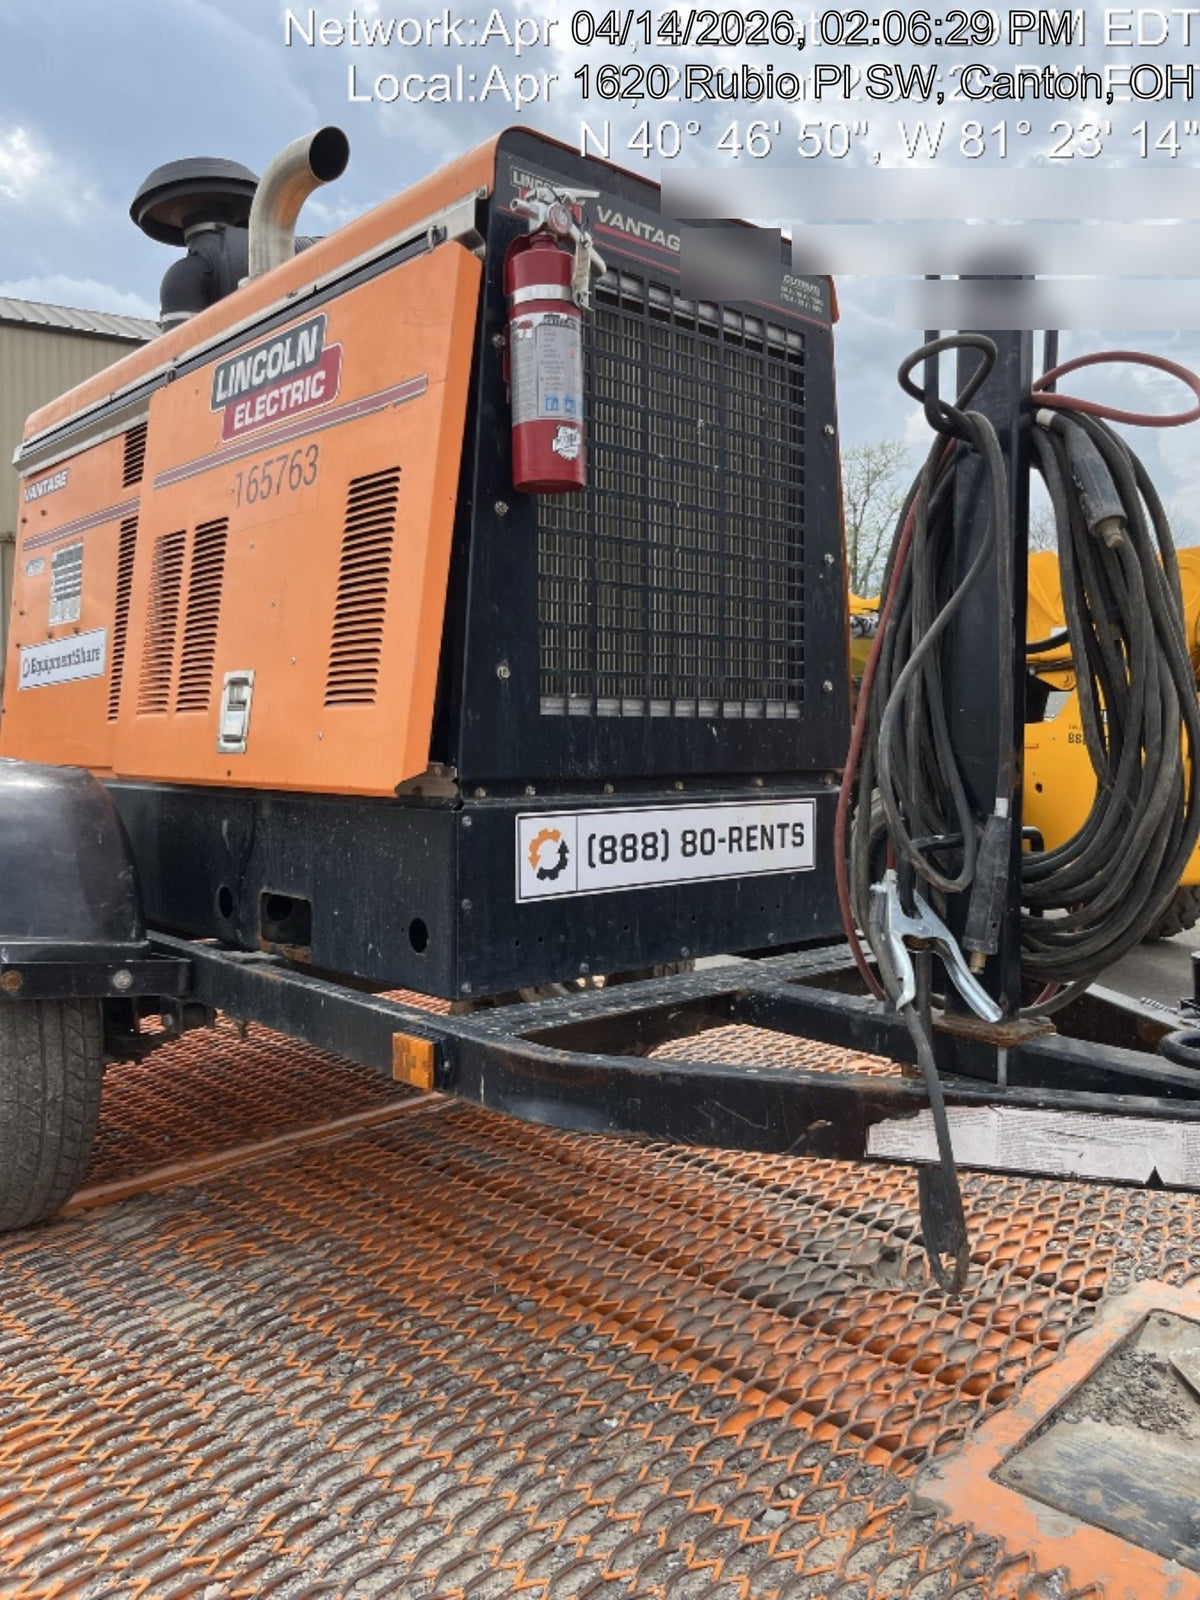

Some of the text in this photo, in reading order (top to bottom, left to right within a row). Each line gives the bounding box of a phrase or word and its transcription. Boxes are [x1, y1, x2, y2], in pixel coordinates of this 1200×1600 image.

[597, 205, 681, 252] VANTAG
[215, 324, 319, 403] LINCOLN
[233, 369, 327, 431] ELECTRIC
[235, 443, 319, 508] 165763
[587, 822, 805, 868] (888) 80-RENTS
